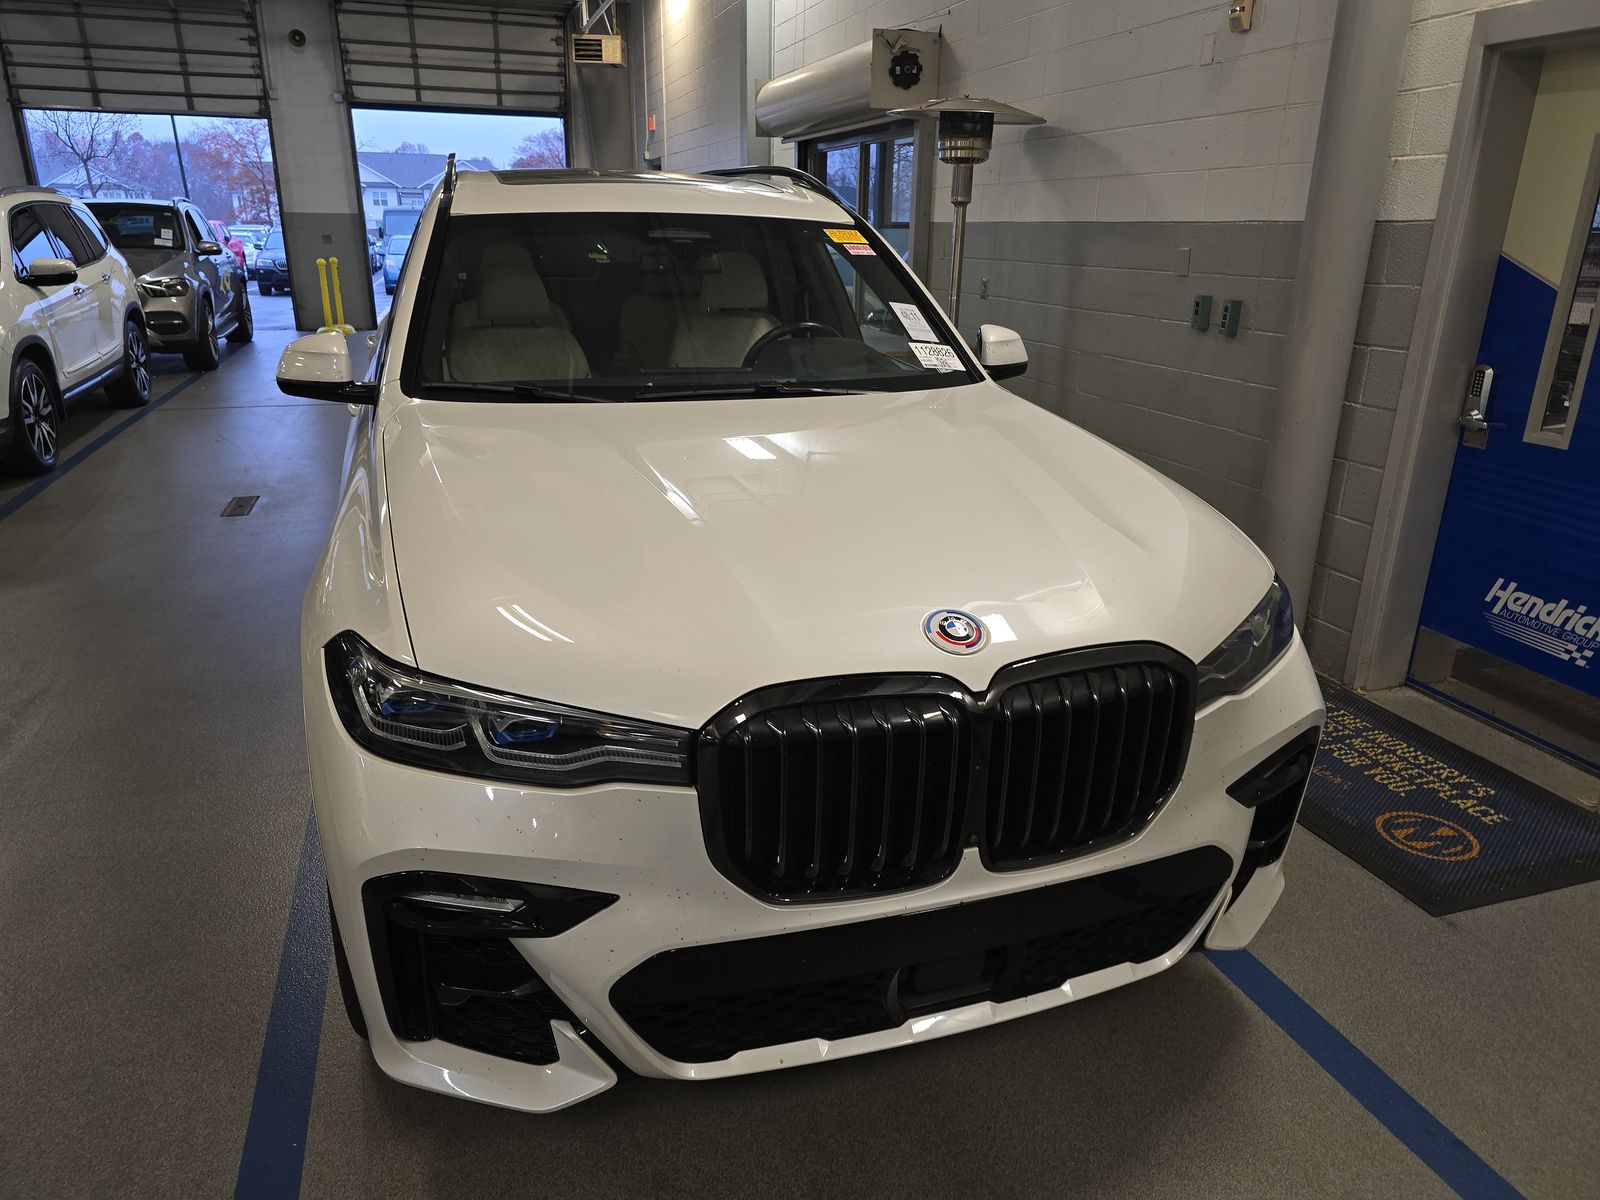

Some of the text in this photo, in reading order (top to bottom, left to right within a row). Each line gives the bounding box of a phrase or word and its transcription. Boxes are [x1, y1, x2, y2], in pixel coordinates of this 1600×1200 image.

[1500, 608, 1600, 649] AUTOMOTIVE GROUP
[1320, 743, 1373, 767] FOR
[1327, 710, 1372, 729] THE
[1361, 730, 1496, 797] INDUSTRY'S
[1344, 738, 1510, 825] MARKETPLACE
